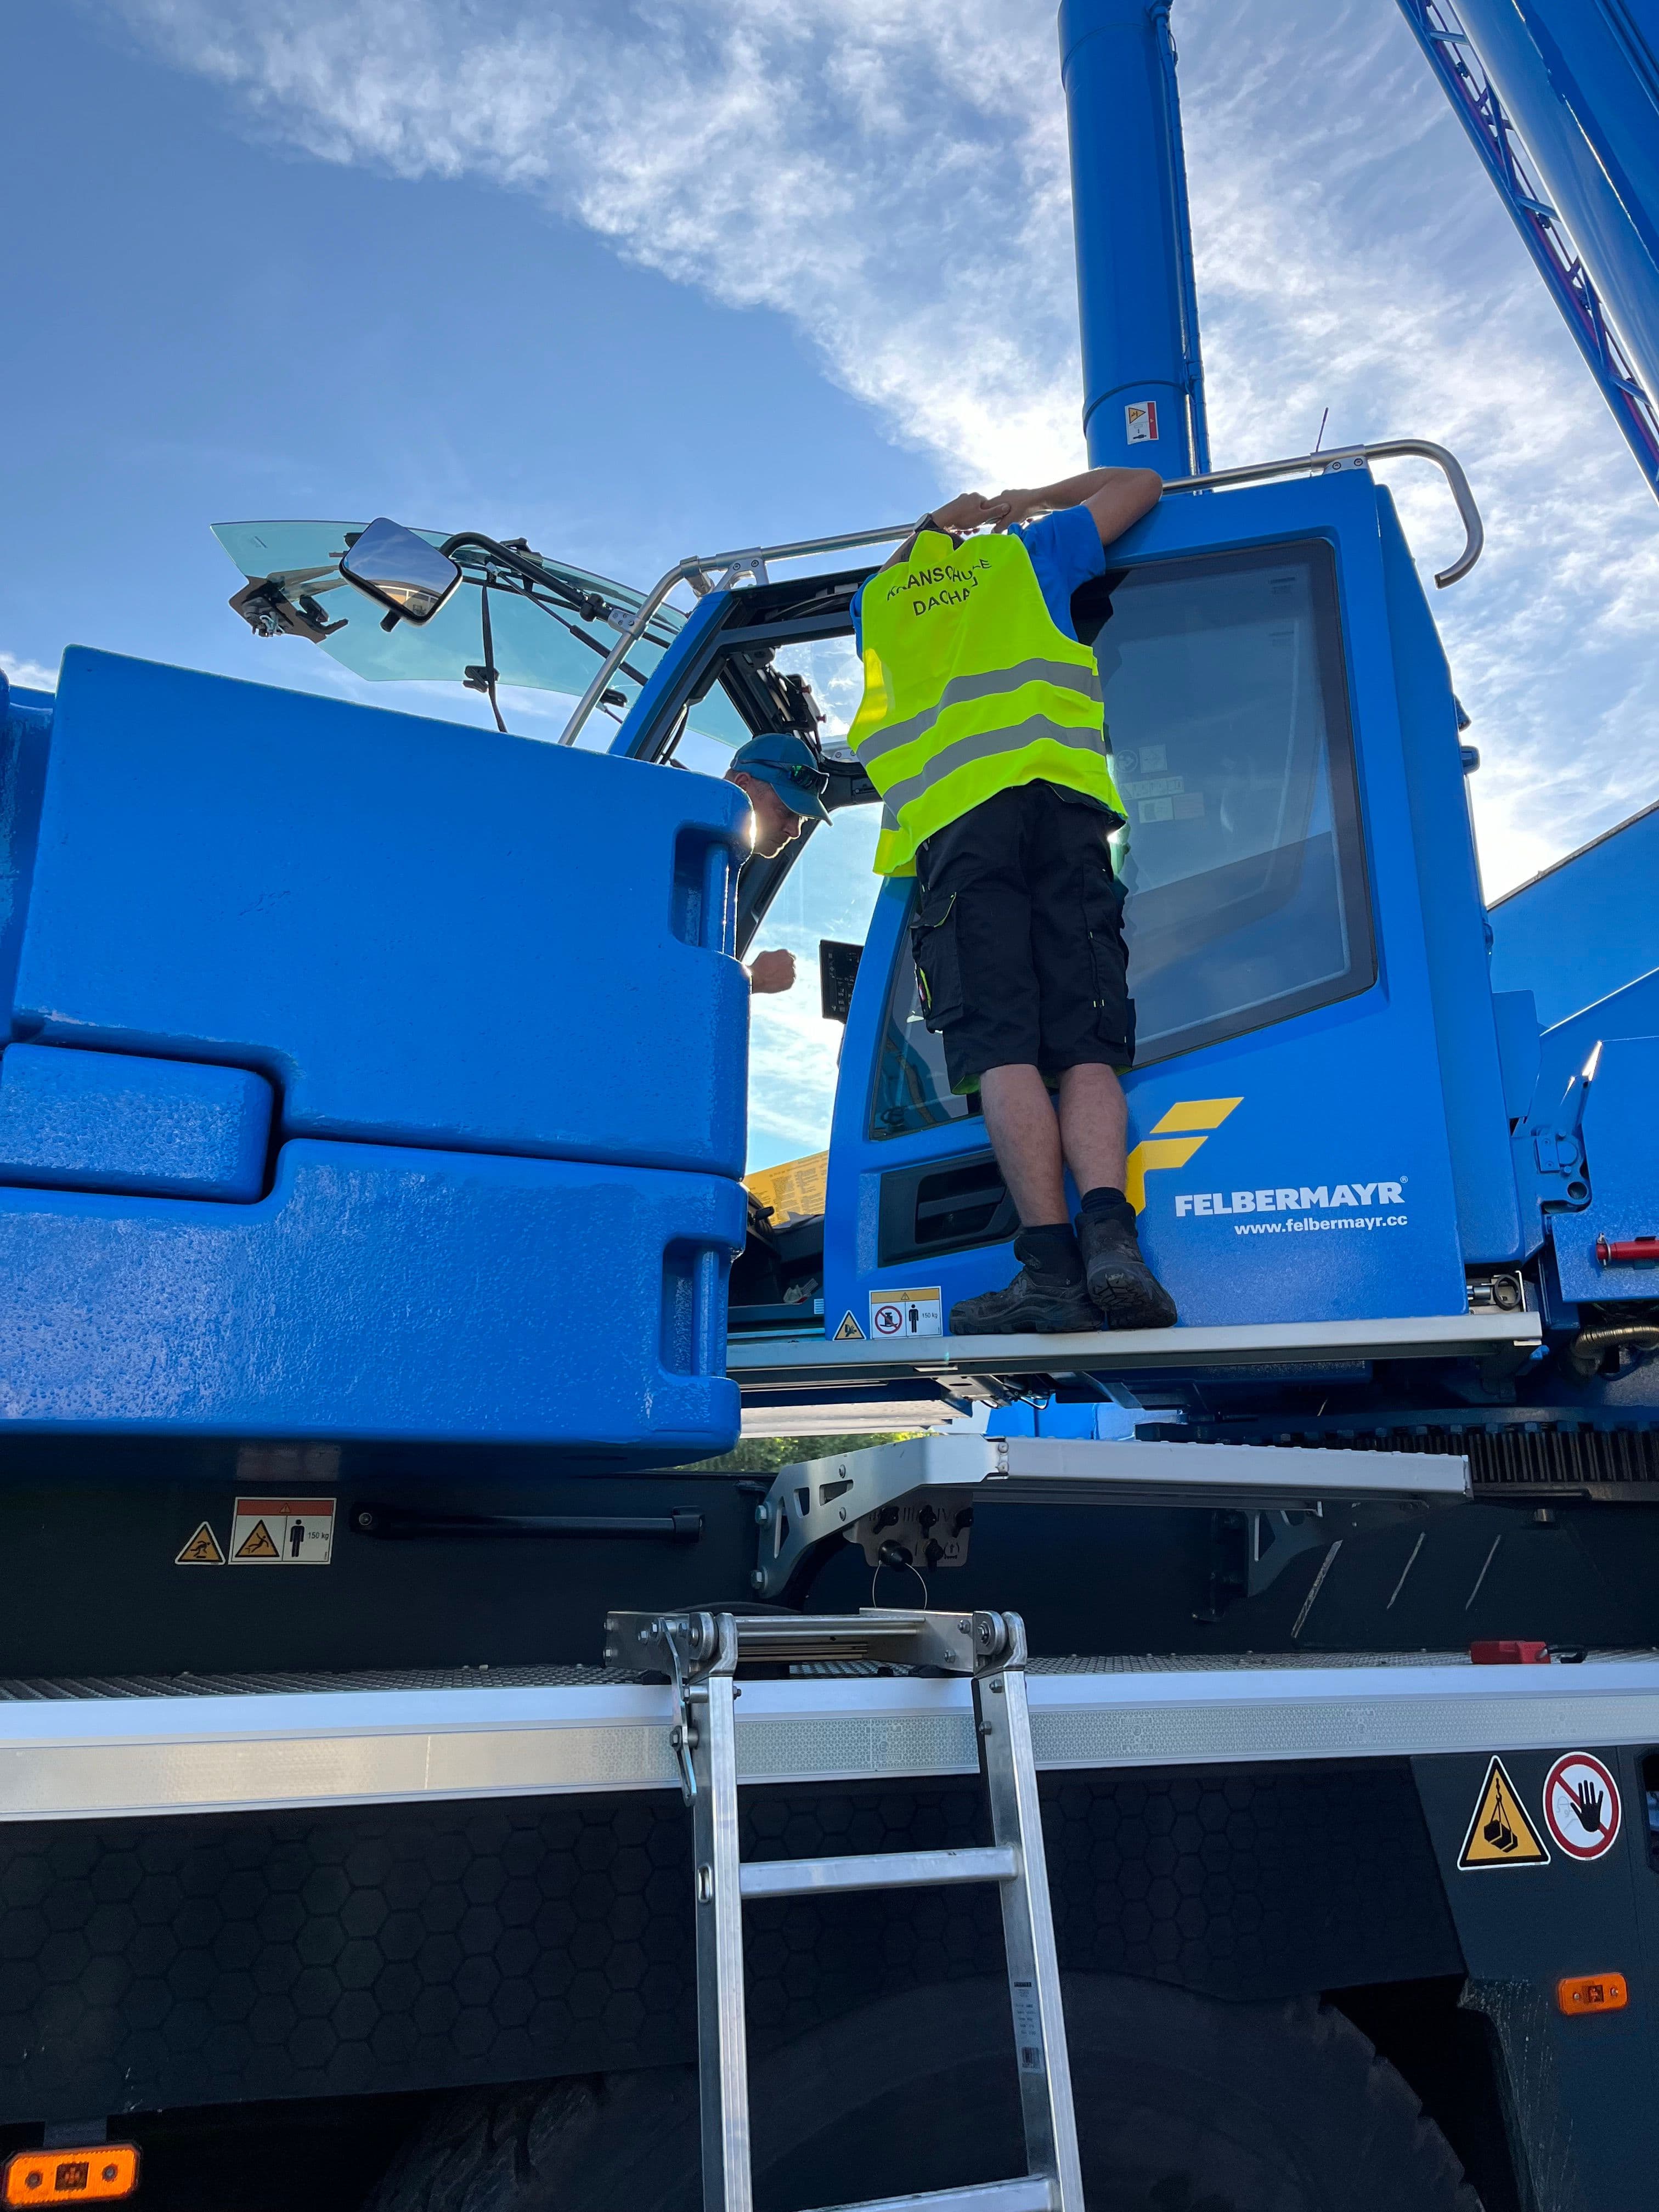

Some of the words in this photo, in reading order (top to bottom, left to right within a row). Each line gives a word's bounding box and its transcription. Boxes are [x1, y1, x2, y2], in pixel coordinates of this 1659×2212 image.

[887, 558, 992, 601] KANSCHUE
[1234, 1215, 1408, 1235] www.felbermayr.cc
[321, 1532, 329, 1541] kg
